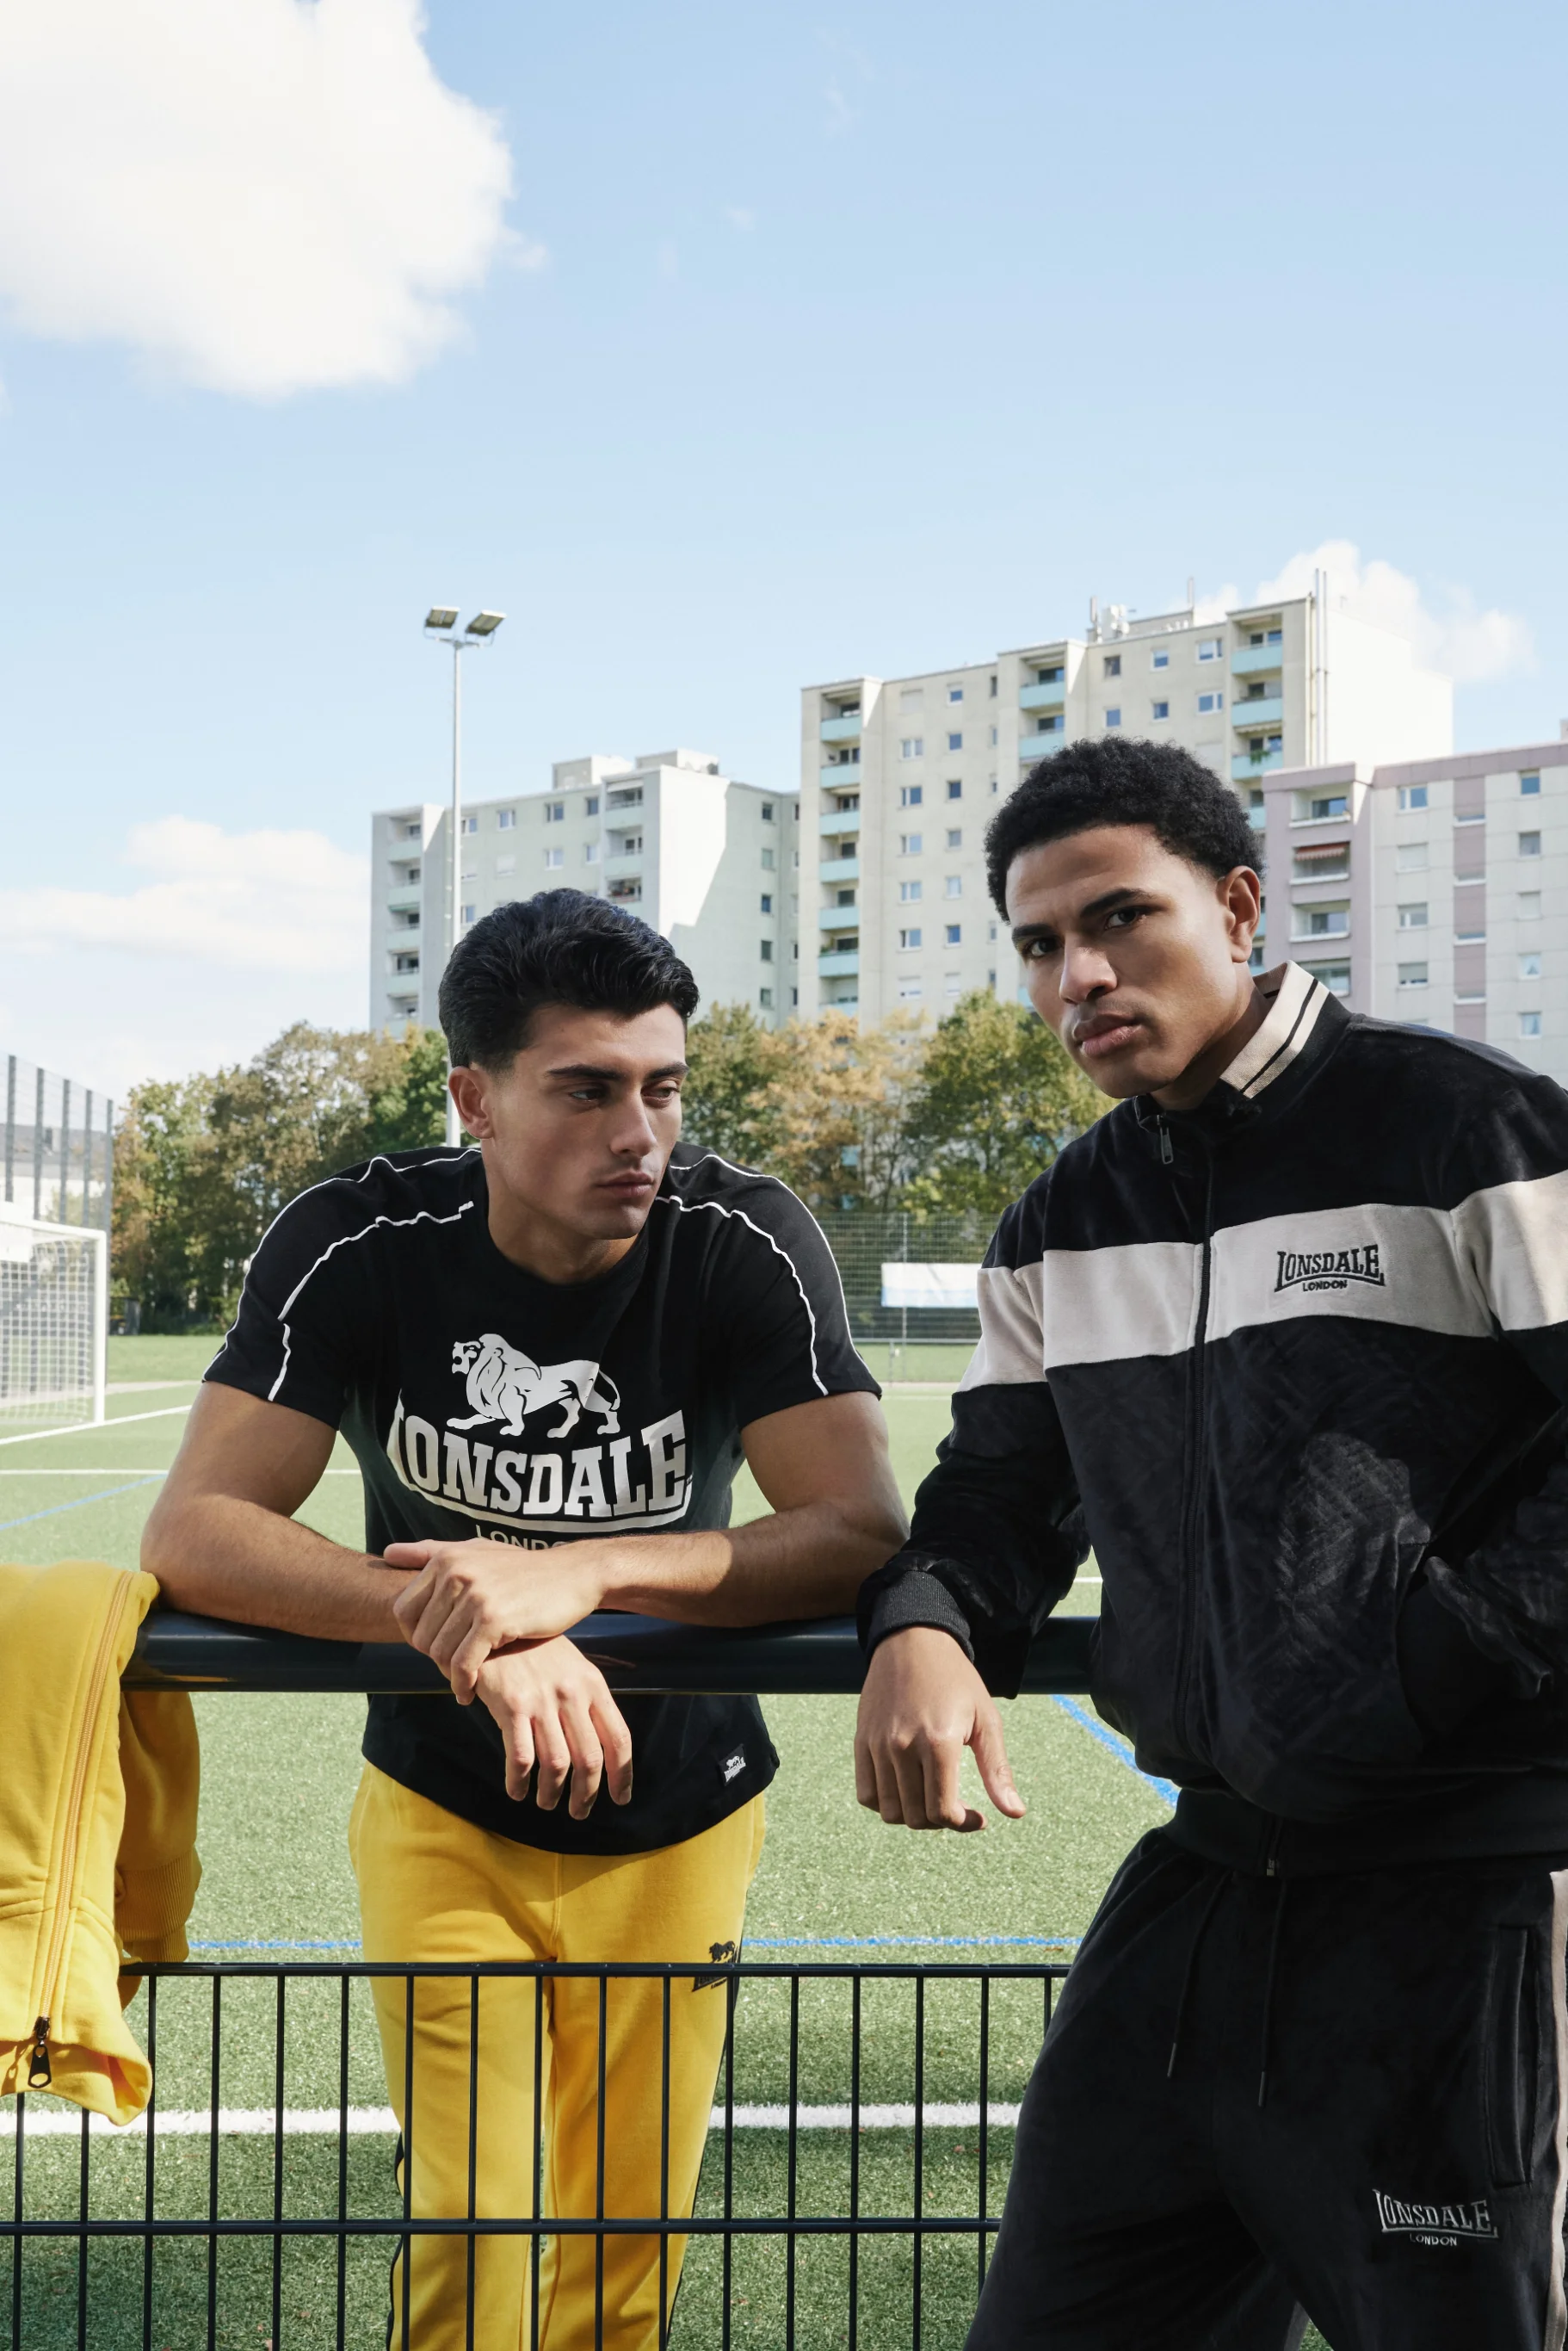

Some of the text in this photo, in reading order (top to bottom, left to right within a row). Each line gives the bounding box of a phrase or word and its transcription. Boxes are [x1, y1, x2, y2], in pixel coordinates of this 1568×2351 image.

[1275, 1245, 1382, 1291] LONSDALE
[1302, 1280, 1348, 1292] LONDON
[1373, 2189, 1495, 2235] LONSDALE
[1410, 2233, 1458, 2247] LONDON
